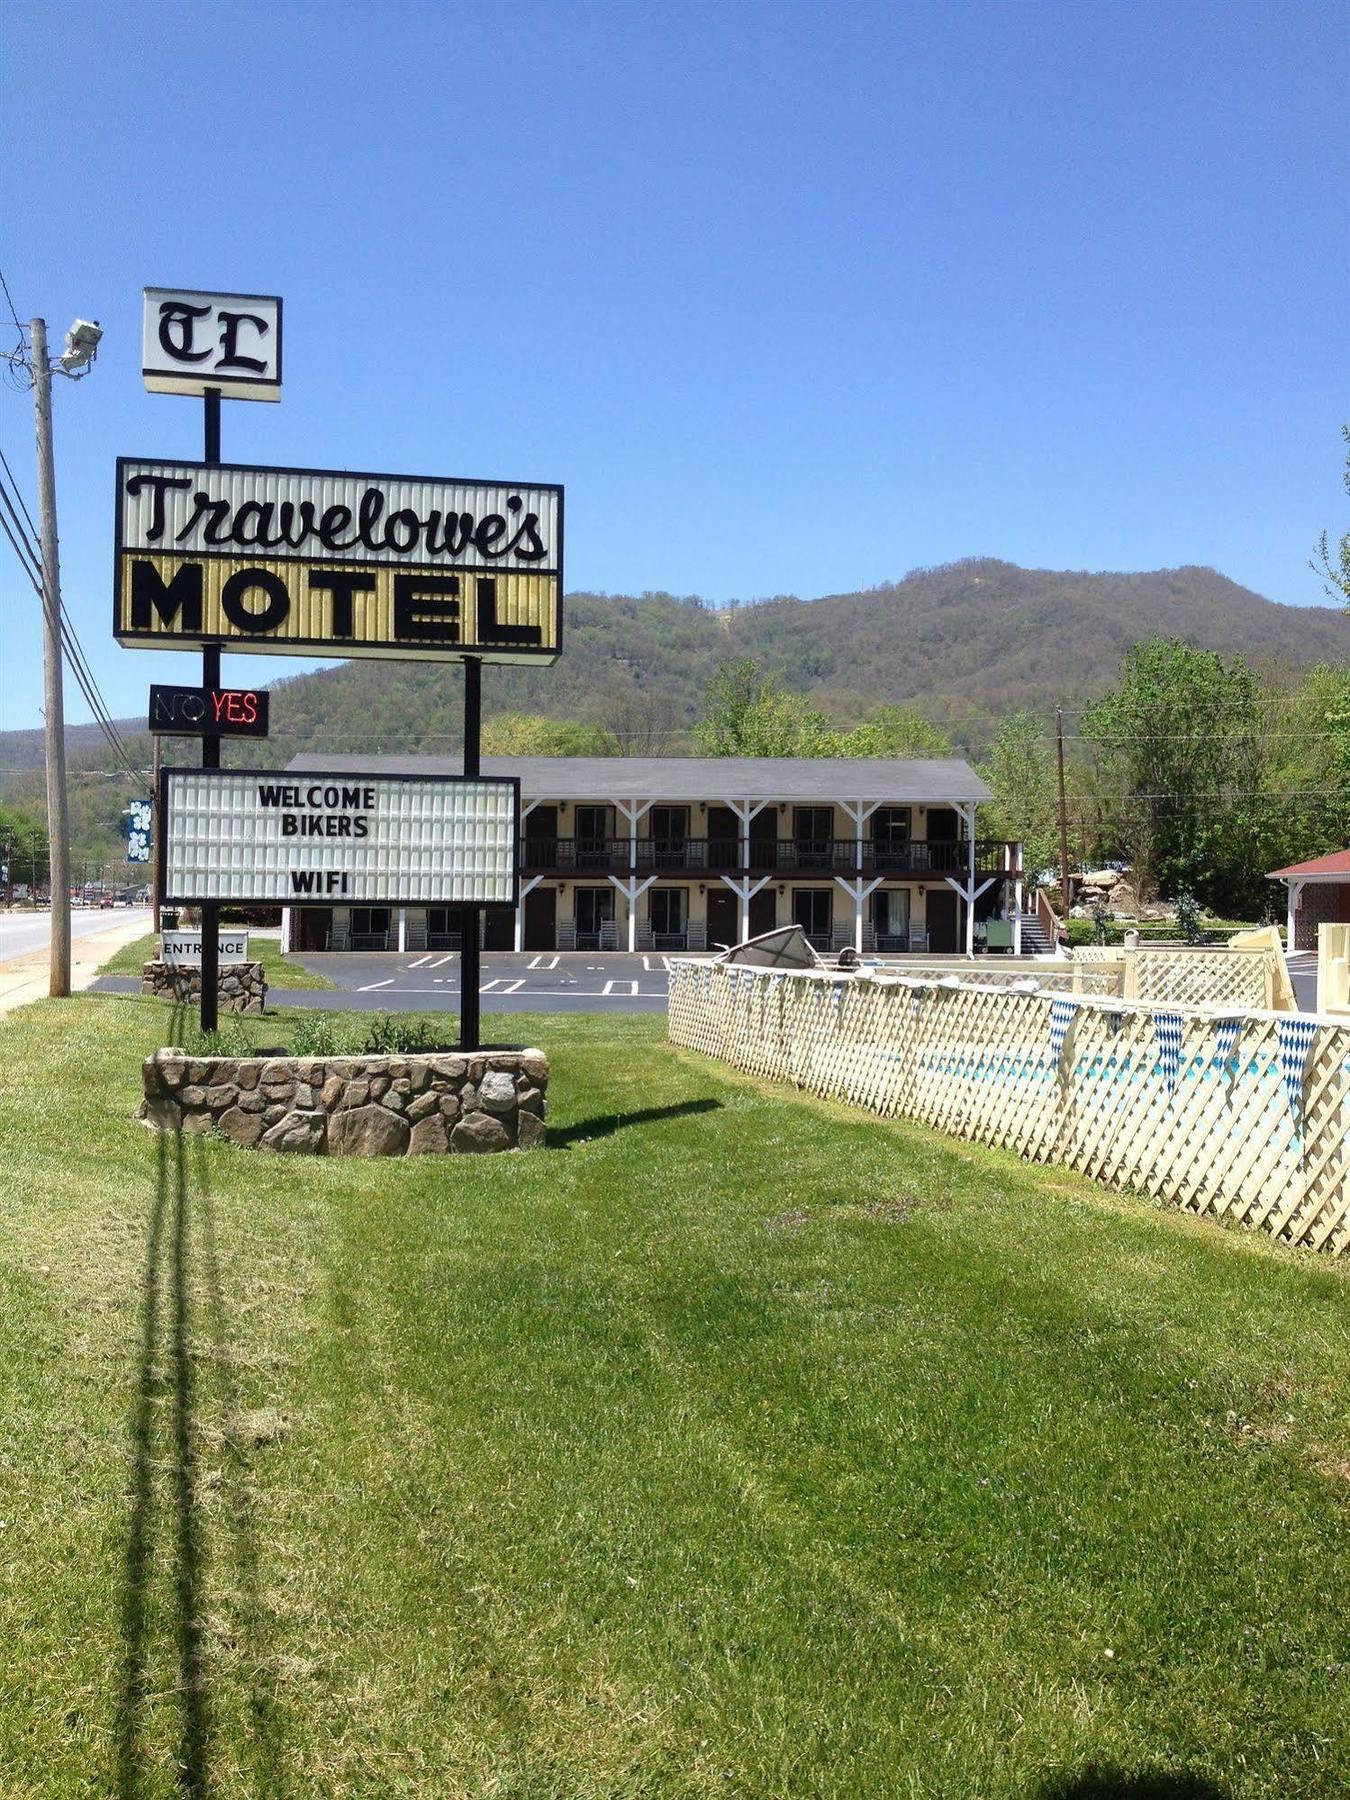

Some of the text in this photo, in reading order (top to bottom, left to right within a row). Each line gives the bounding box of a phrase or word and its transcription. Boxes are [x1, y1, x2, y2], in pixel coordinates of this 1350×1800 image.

[158, 301, 269, 373] TL
[126, 475, 548, 561] Travelowe's
[131, 560, 542, 644] MOTEL
[155, 691, 257, 723] NO YES
[259, 785, 375, 809] WELCOME
[282, 815, 369, 838] BIKERS
[291, 871, 348, 893] WIFI
[164, 942, 244, 954] ENTRNCE
